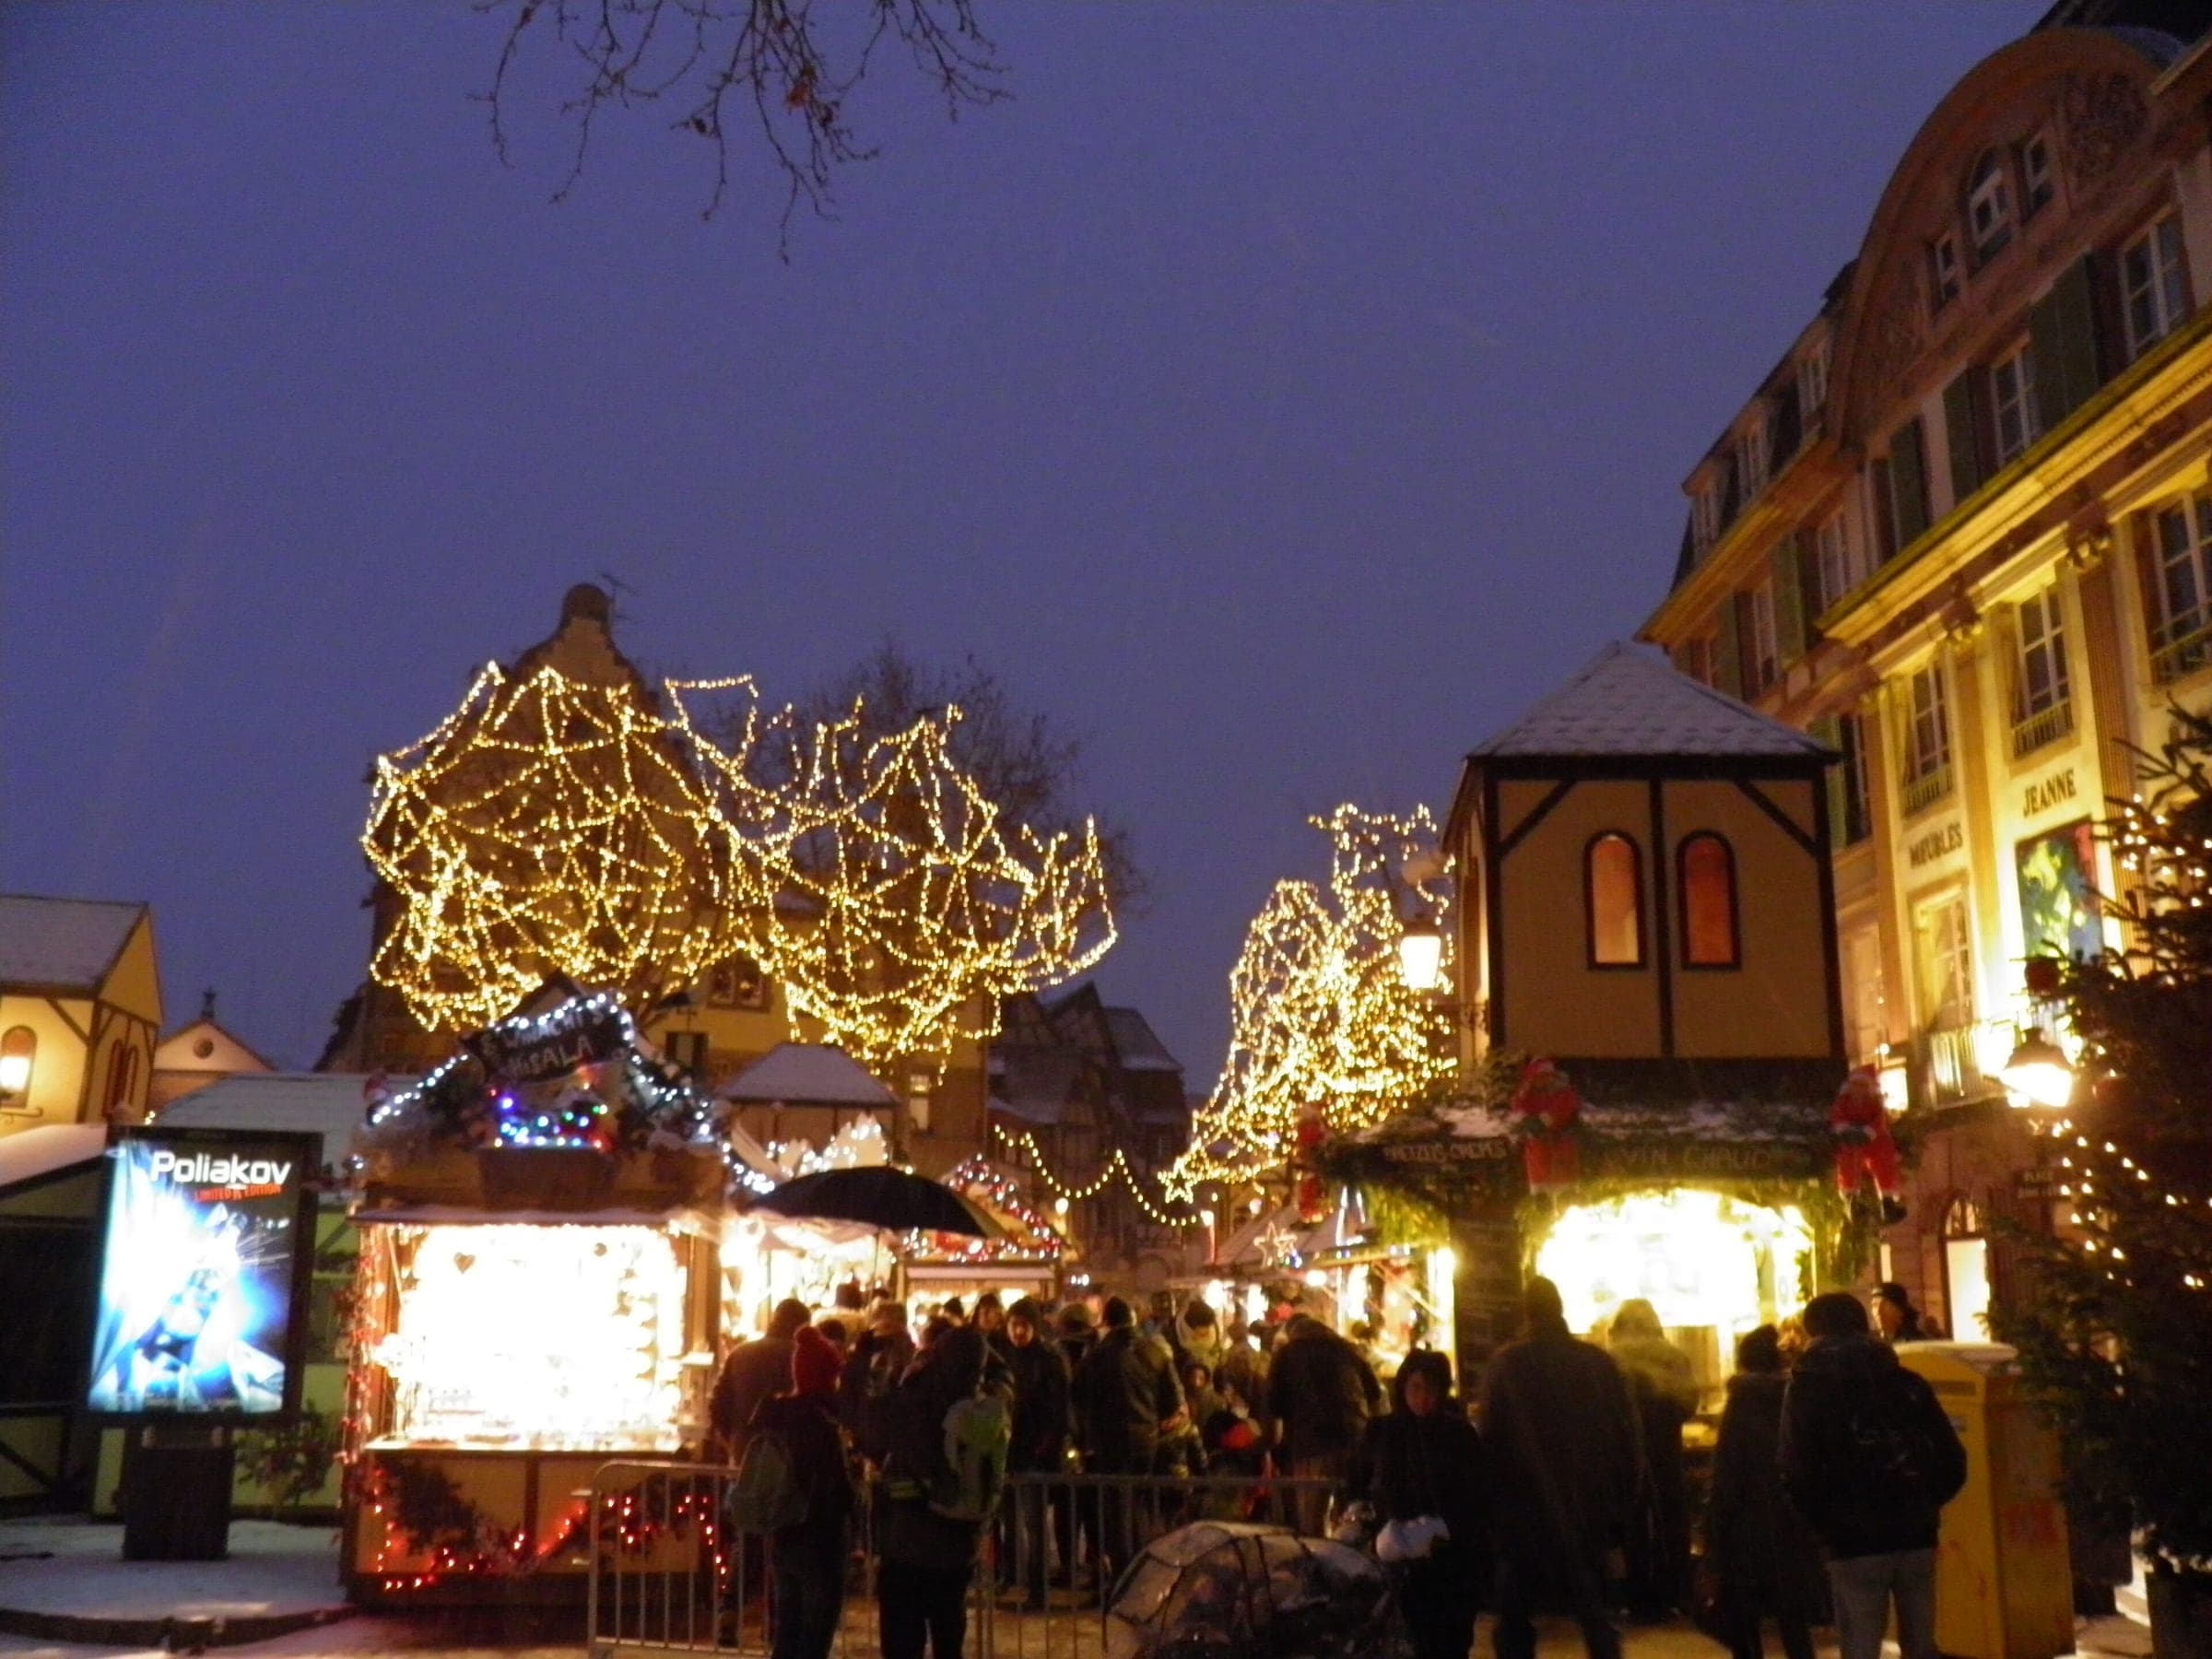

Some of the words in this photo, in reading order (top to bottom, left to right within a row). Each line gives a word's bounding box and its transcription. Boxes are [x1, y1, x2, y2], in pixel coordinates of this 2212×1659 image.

[2023, 768, 2077, 818] JEANNE
[1909, 822, 1964, 868] MEUBLES
[150, 1150, 292, 1186] Poliakov
[194, 1187, 231, 1203] LIMITED
[244, 1183, 282, 1197] EDITION
